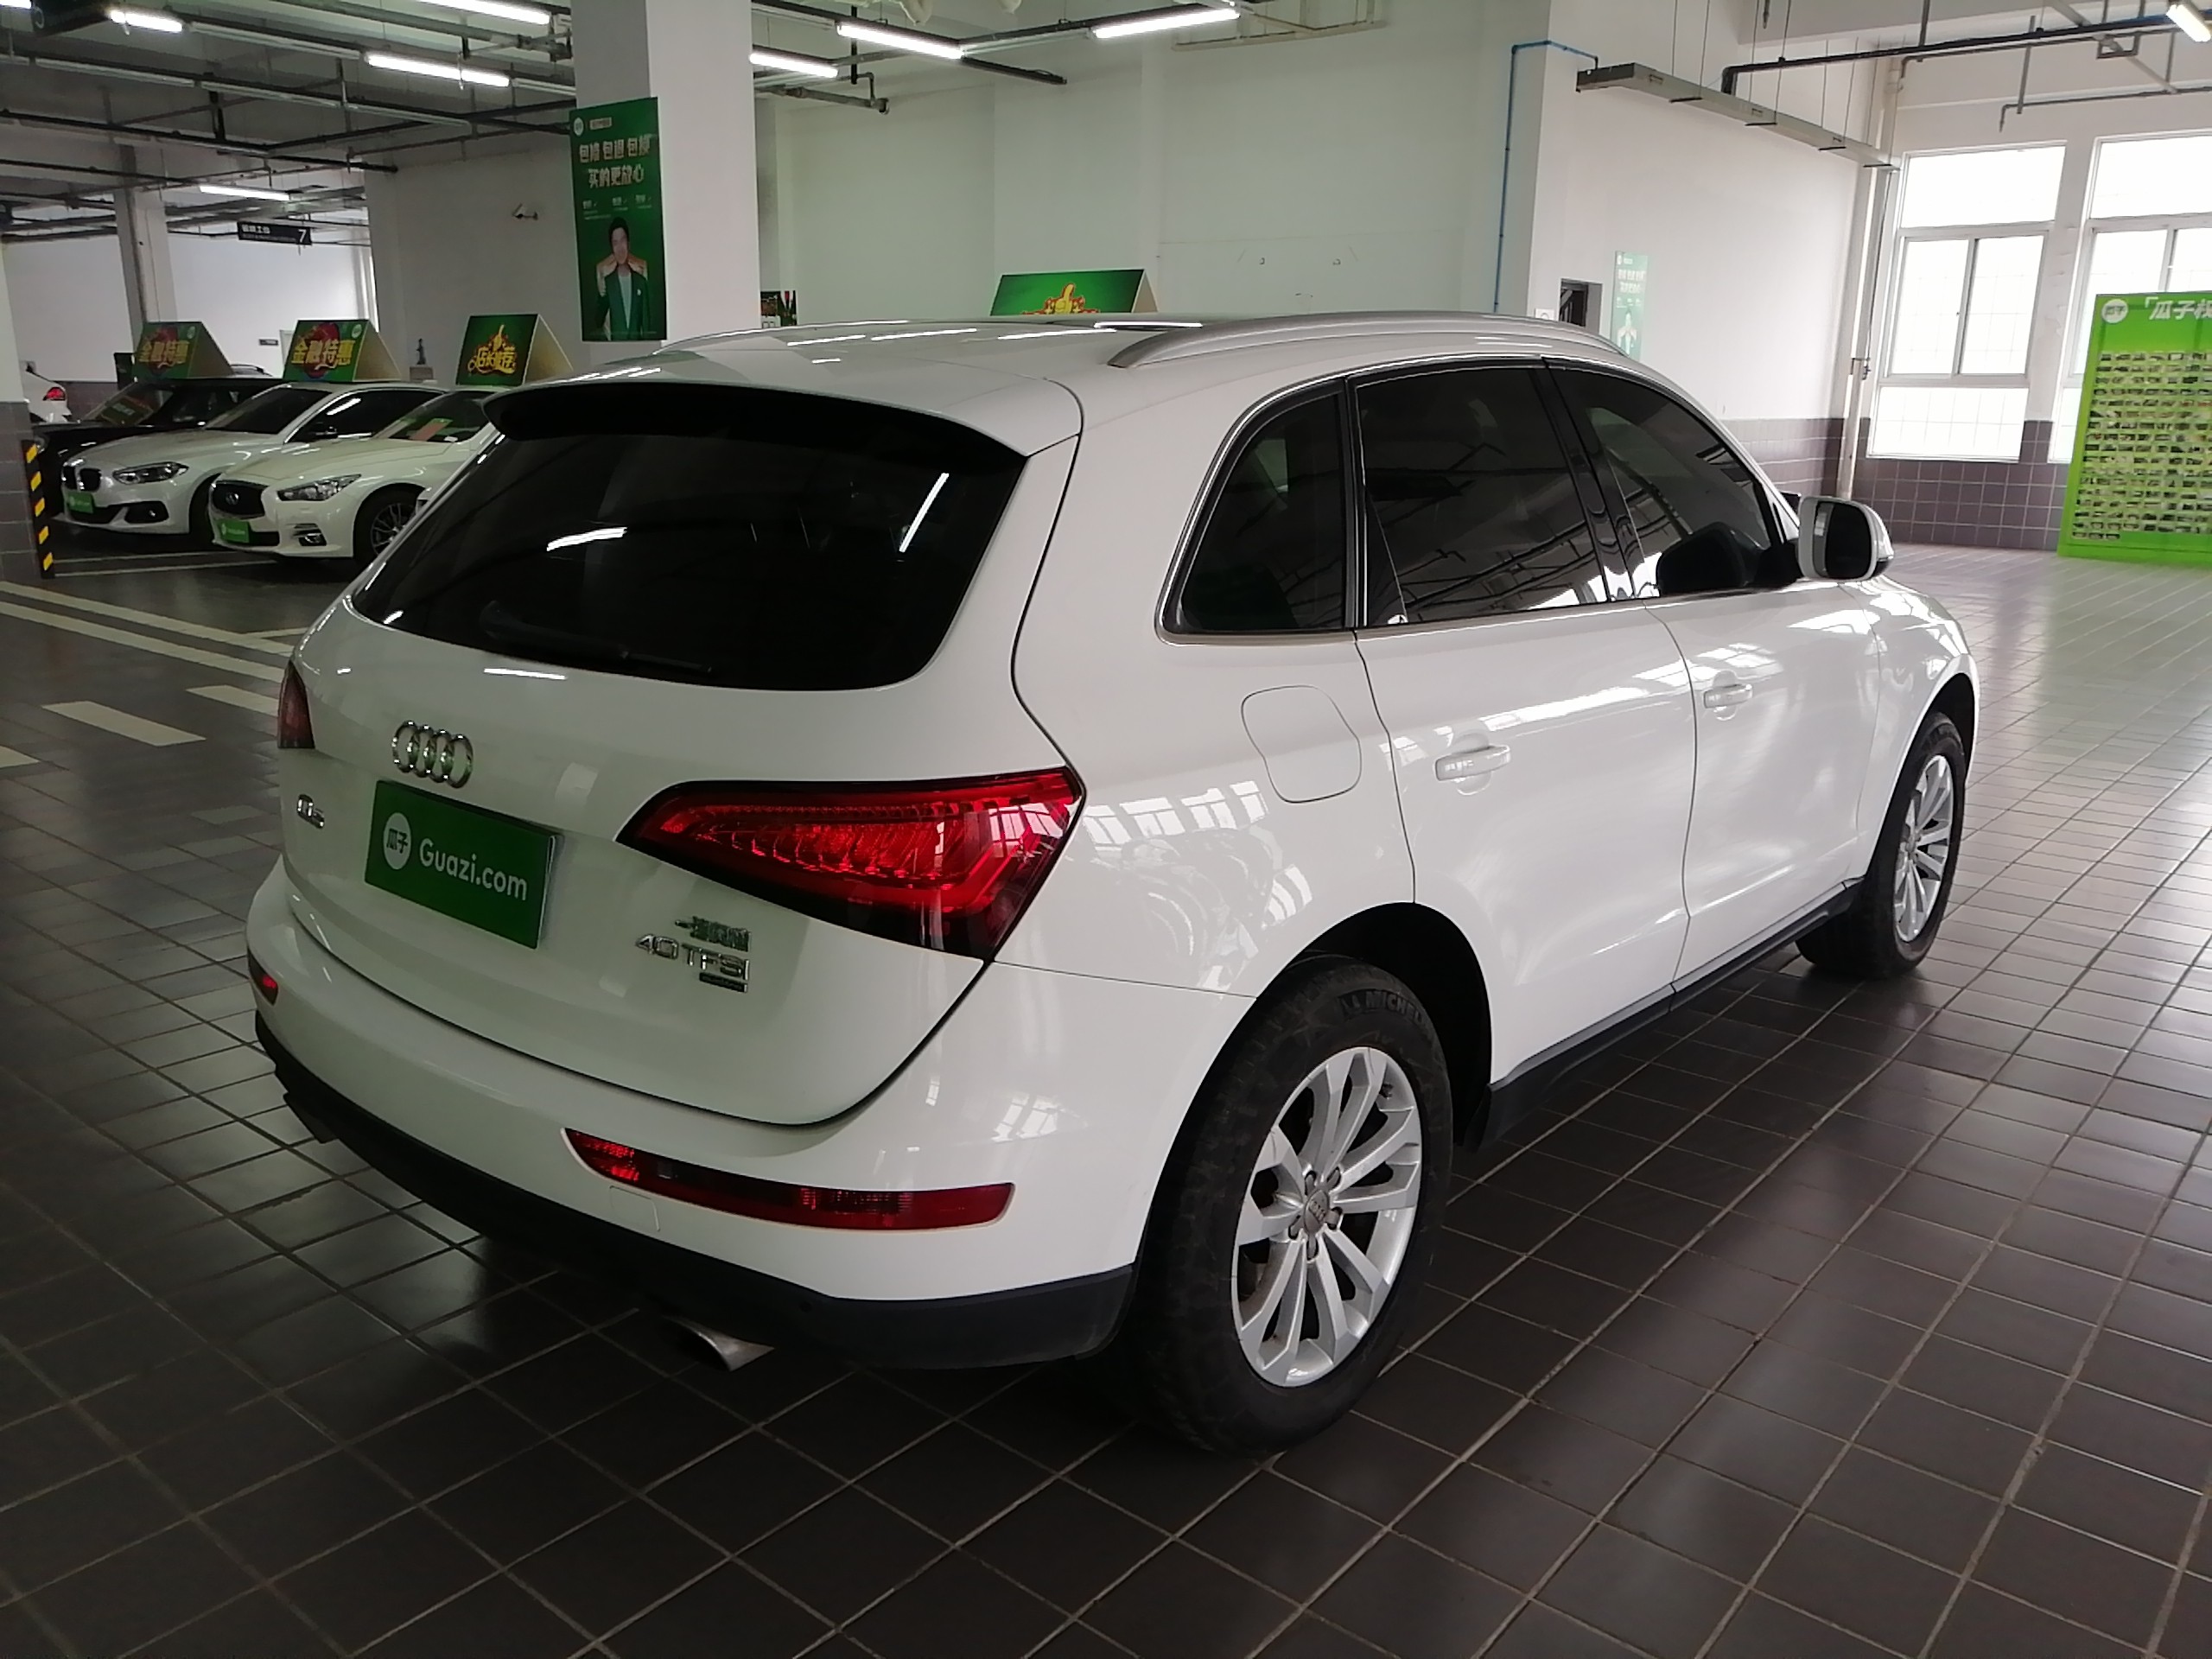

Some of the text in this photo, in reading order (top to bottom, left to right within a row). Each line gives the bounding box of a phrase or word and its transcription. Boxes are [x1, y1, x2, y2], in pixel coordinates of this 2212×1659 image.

[297, 229, 307, 243] 7
[290, 337, 356, 367] 金融特惠
[386, 827, 409, 855] 瓜子
[419, 837, 528, 900] Guazi.com
[635, 933, 679, 960] 40
[681, 943, 750, 982] TFSI
